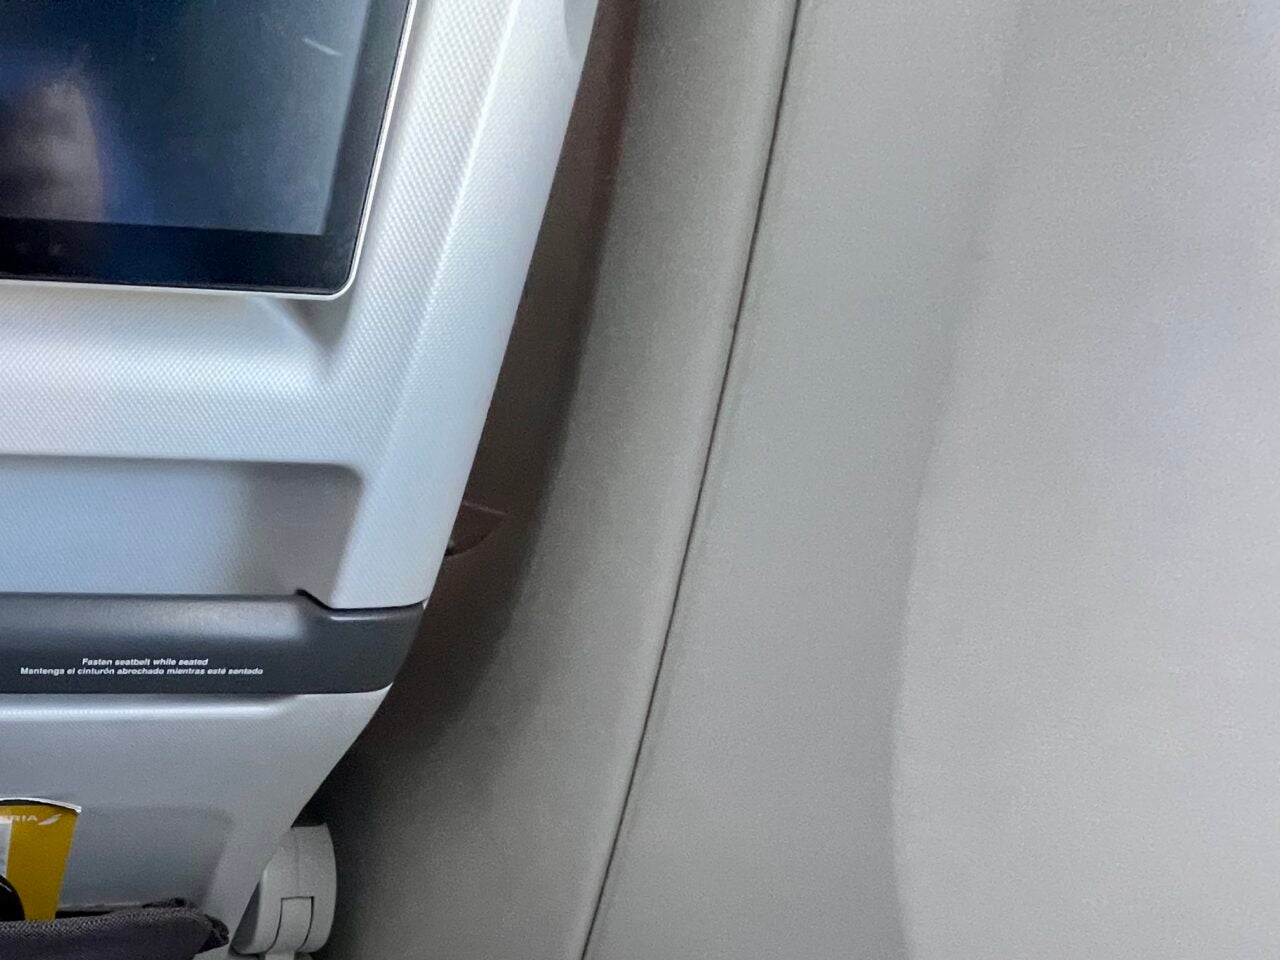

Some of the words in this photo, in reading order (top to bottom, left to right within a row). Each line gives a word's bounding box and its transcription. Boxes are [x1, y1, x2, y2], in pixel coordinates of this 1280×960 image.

[82, 658, 113, 666] Fasten
[114, 658, 150, 666] seatbelt
[153, 658, 176, 666] while
[178, 658, 208, 666] seated
[20, 667, 65, 676] Mantenga
[67, 667, 75, 675] el
[77, 667, 114, 675] cinturón
[116, 667, 164, 675] abrochado
[167, 667, 205, 675] mientras
[207, 667, 226, 675] esté
[228, 667, 263, 675] sentado
